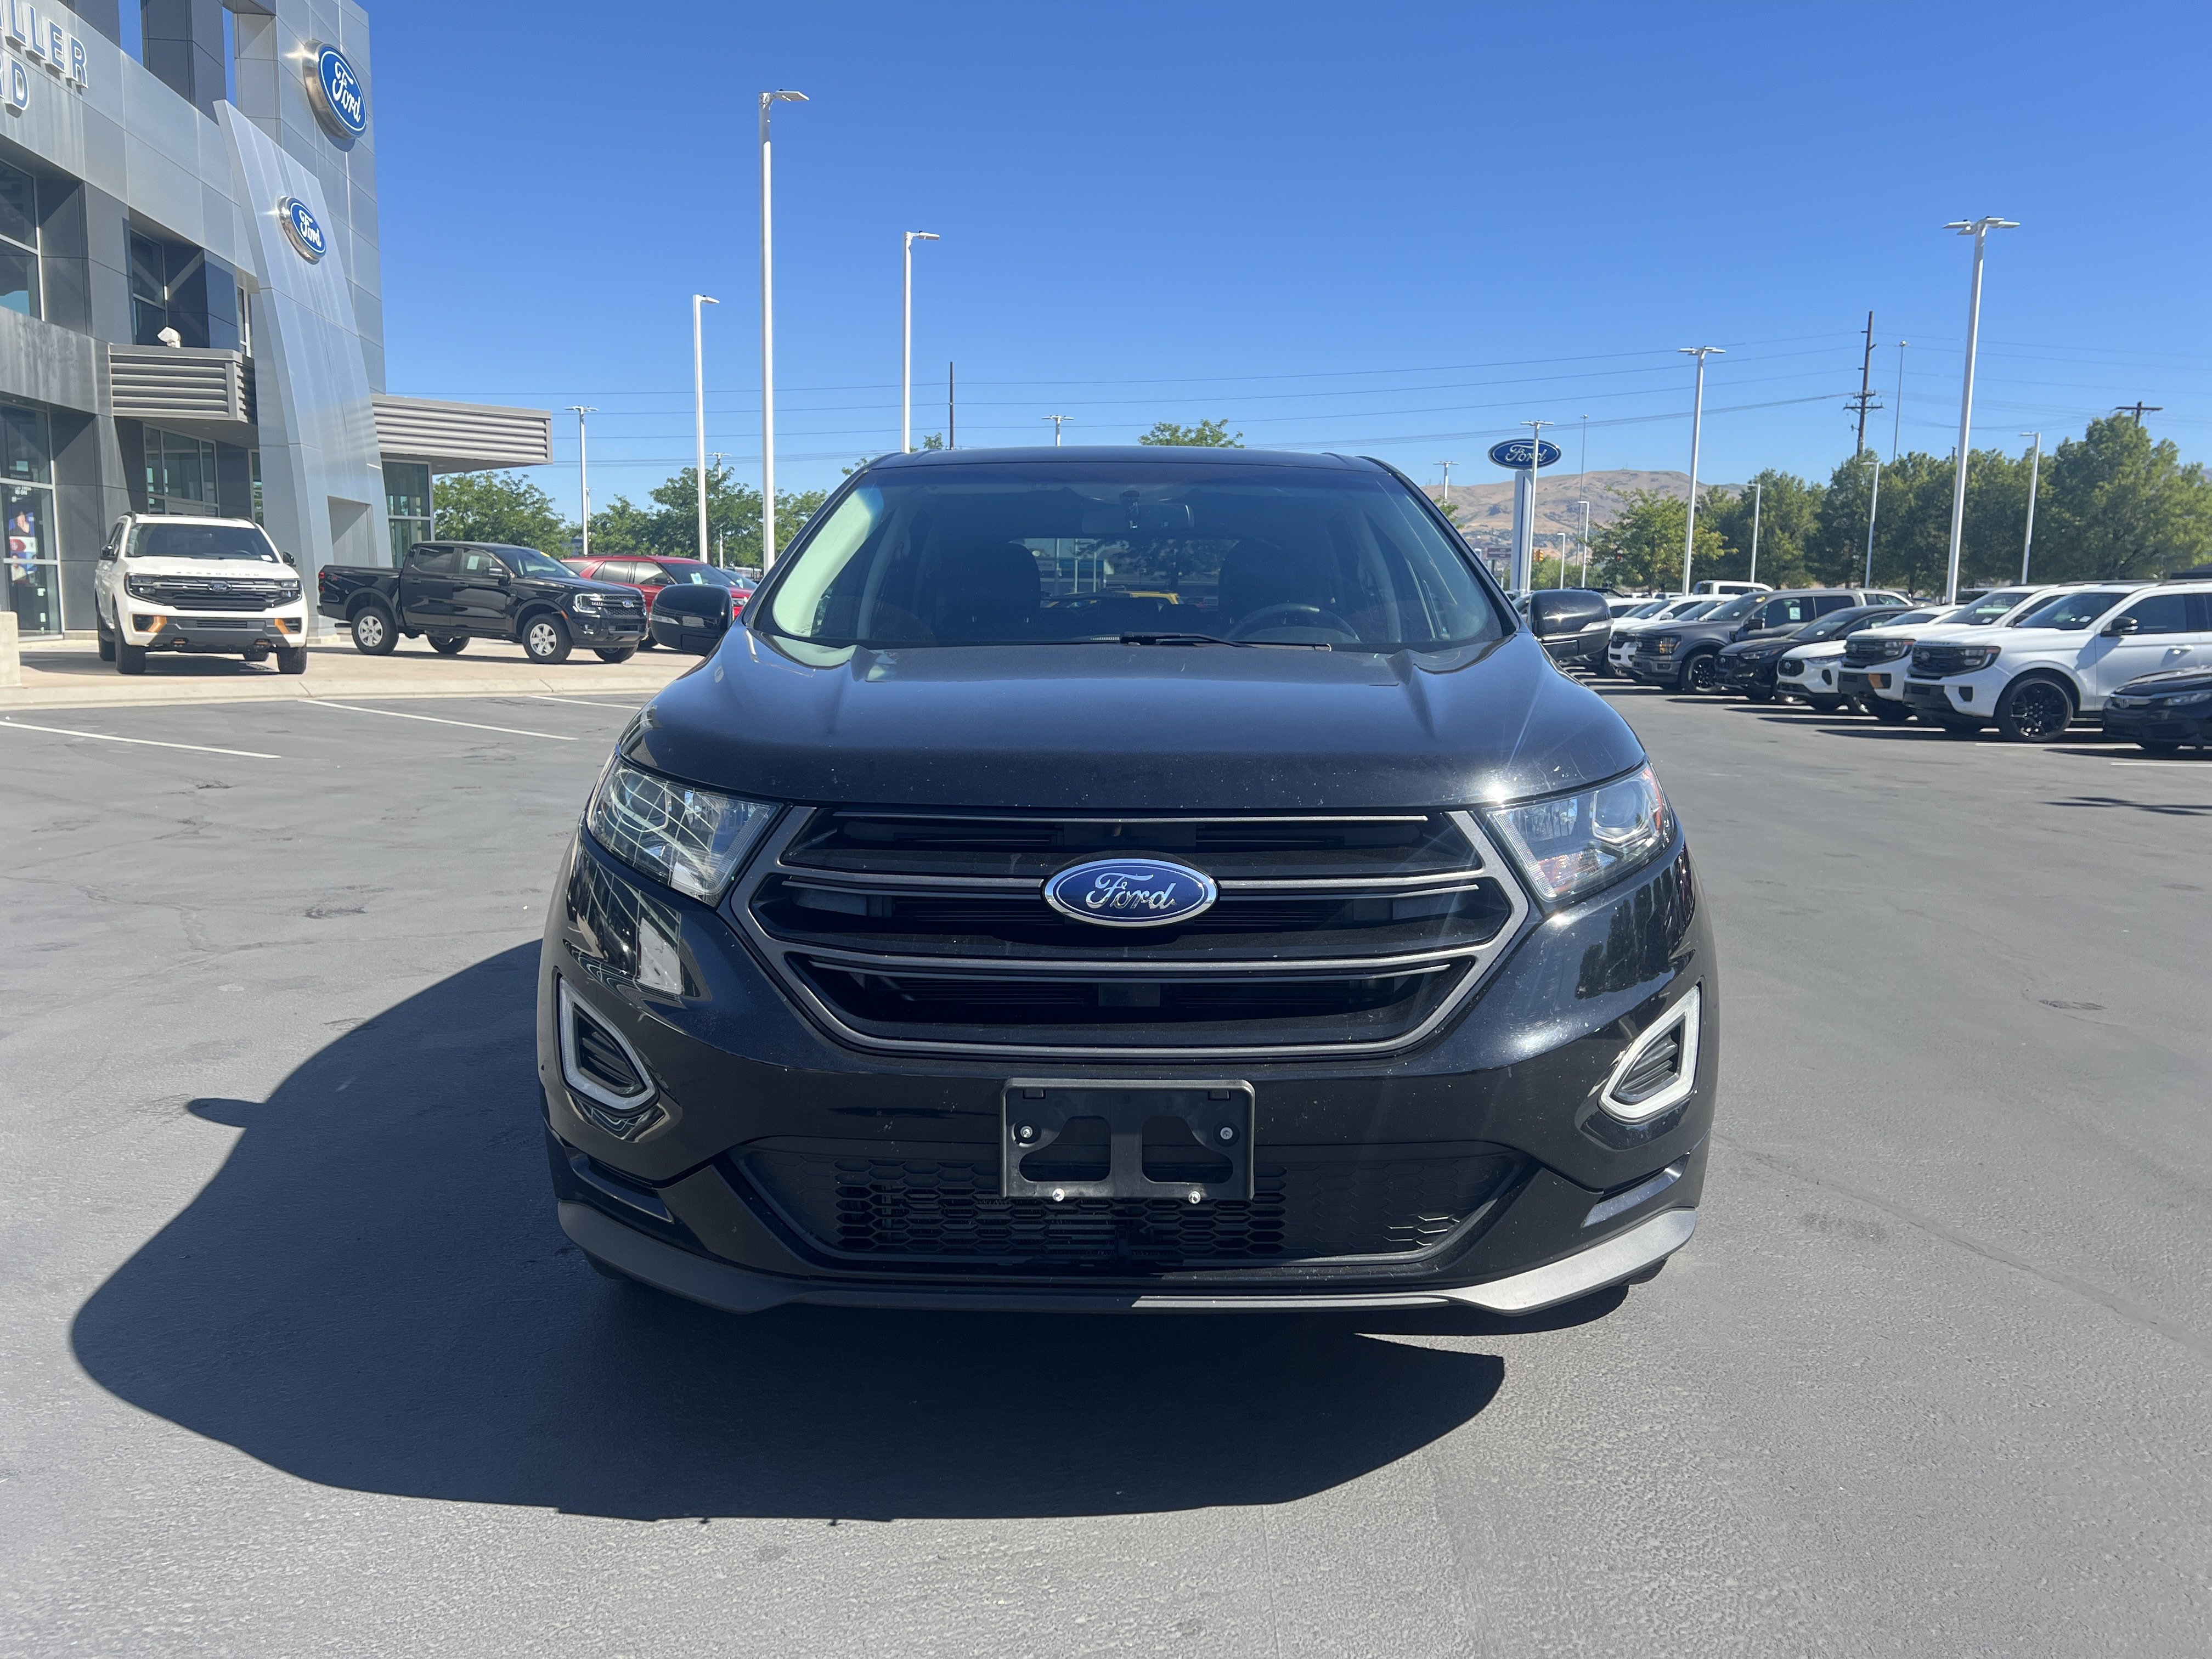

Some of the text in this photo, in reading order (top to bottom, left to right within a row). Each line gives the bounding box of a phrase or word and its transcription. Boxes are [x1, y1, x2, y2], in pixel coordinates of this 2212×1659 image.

[332, 61, 361, 122] Ford
[298, 210, 321, 247] Ford
[1085, 872, 1176, 909] Ford
